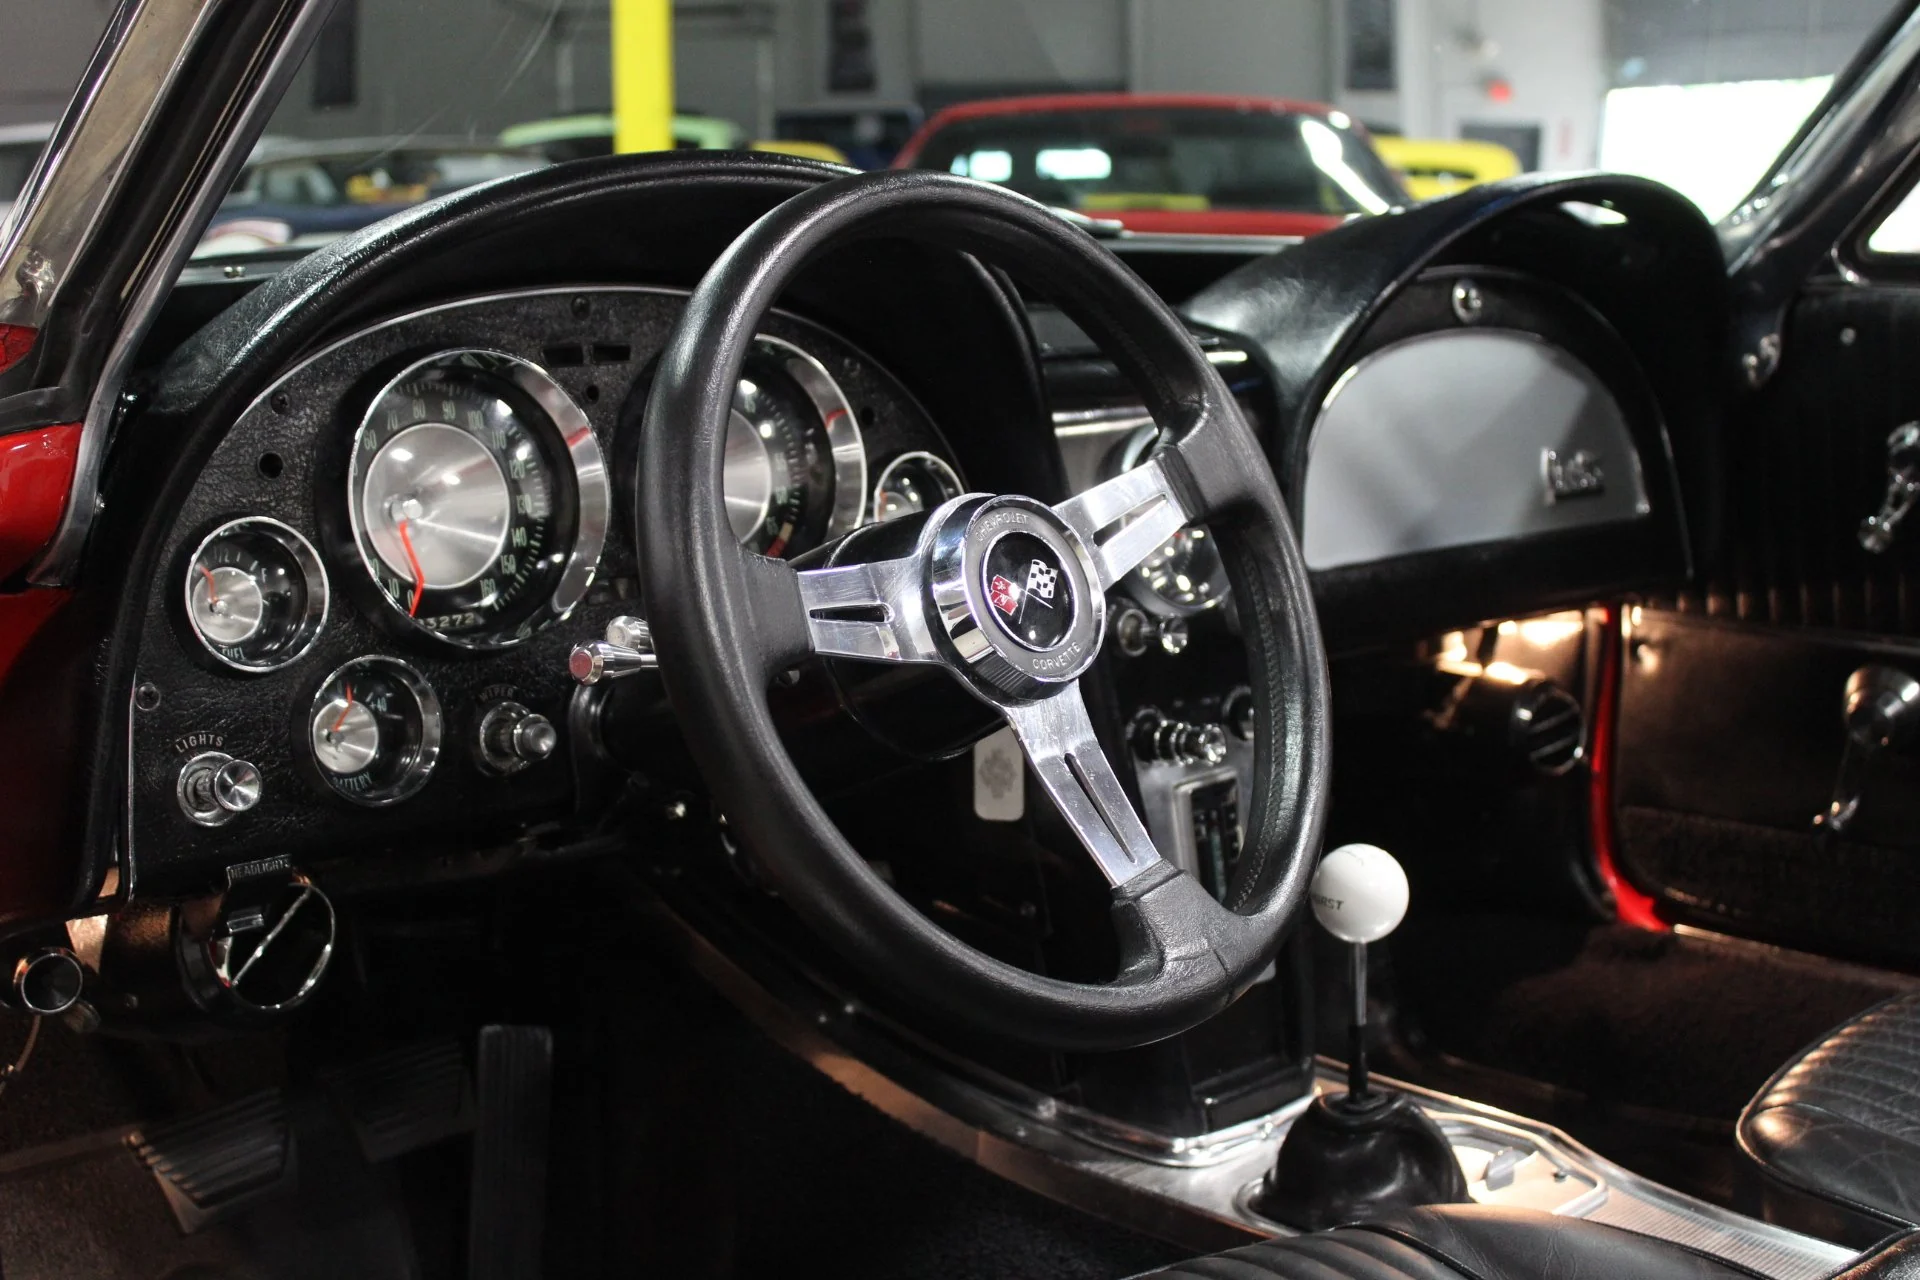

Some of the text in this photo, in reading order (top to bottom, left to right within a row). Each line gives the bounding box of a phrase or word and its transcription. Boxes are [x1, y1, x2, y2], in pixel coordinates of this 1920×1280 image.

[413, 400, 426, 419] 80
[443, 401, 456, 420] 90
[387, 412, 399, 431] 70
[467, 410, 485, 430] 100
[363, 430, 378, 451] 60
[491, 426, 507, 449] 110
[510, 459, 524, 479] 120
[516, 495, 532, 513] 130
[511, 526, 528, 547] 140
[976, 512, 1029, 542] CHEVROLET
[501, 554, 517, 575] 150
[388, 578, 400, 600] 10
[480, 578, 496, 598] 160
[221, 647, 246, 661] FUEL
[1032, 641, 1082, 670] CORVETTE
[369, 697, 387, 712] +40
[479, 687, 514, 702] WIPER
[175, 734, 225, 753] LIGHTS
[332, 771, 373, 792] BATTERY
[230, 858, 291, 880] HEADLIGHTS
